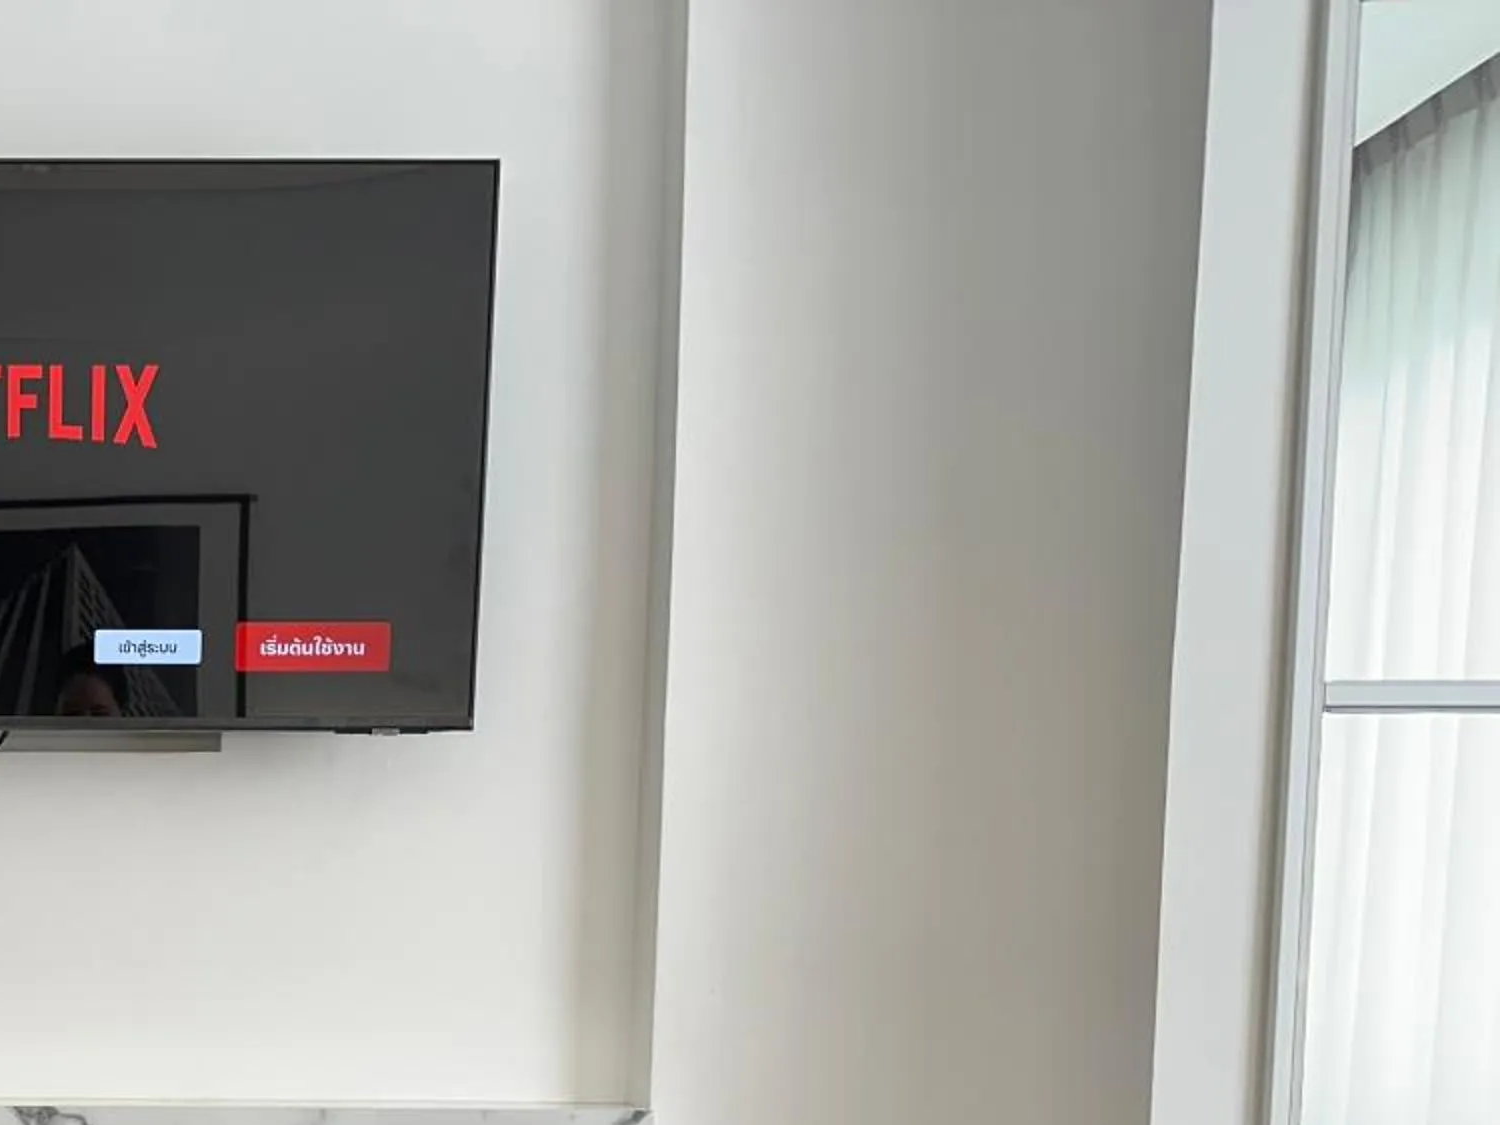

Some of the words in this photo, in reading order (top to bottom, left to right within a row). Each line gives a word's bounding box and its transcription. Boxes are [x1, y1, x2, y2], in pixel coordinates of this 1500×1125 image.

[118, 639, 177, 658] เข้าสู่ระบบ
[260, 633, 365, 656] เริ่มต้นใช้งาน
